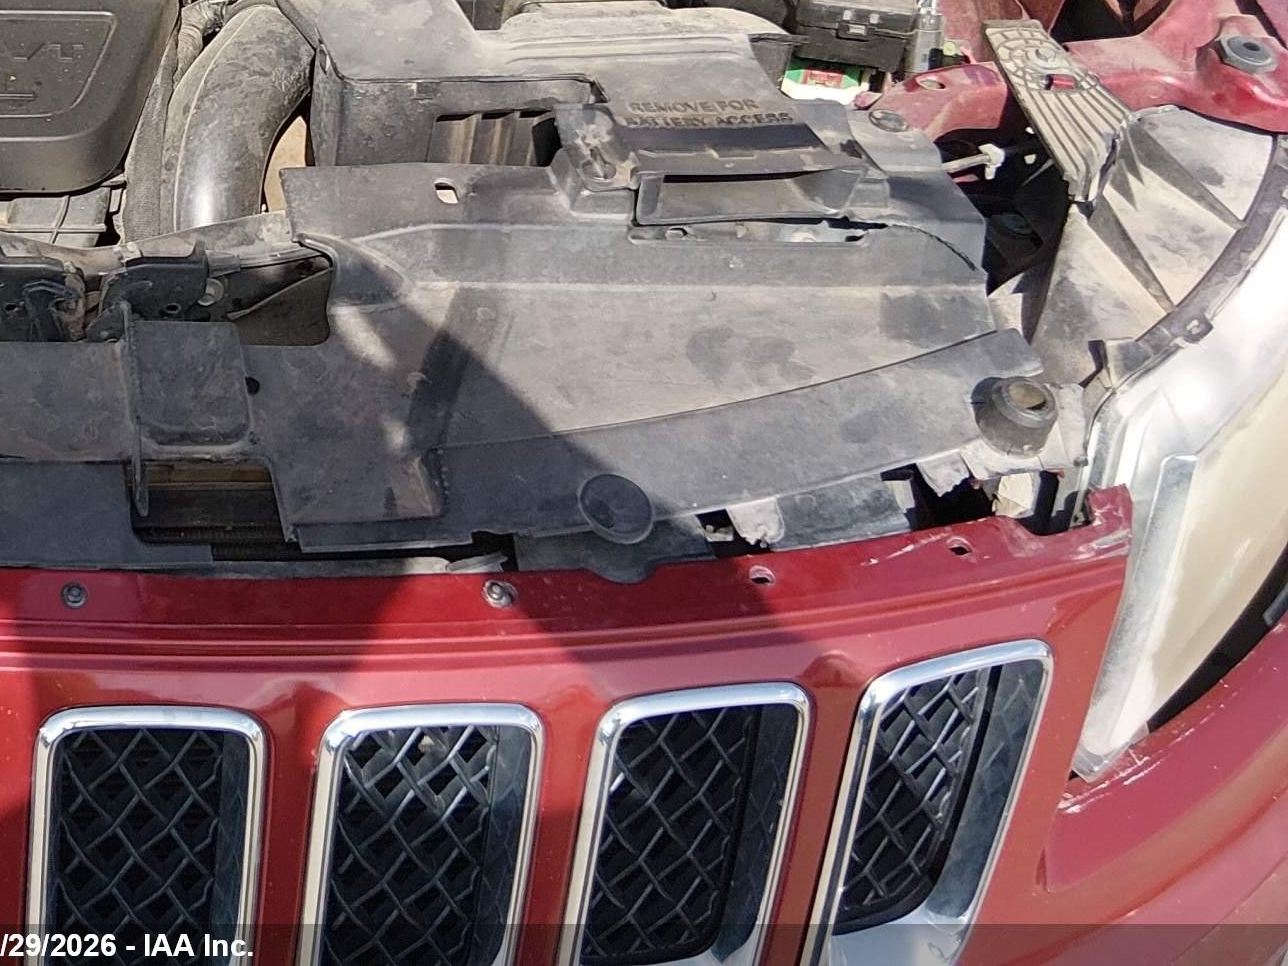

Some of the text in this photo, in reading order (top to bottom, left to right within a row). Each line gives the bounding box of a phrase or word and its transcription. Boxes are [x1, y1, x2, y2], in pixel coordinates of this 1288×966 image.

[627, 98, 760, 114] REMOVE FOR
[624, 112, 794, 129] BATTERY ACCESS
